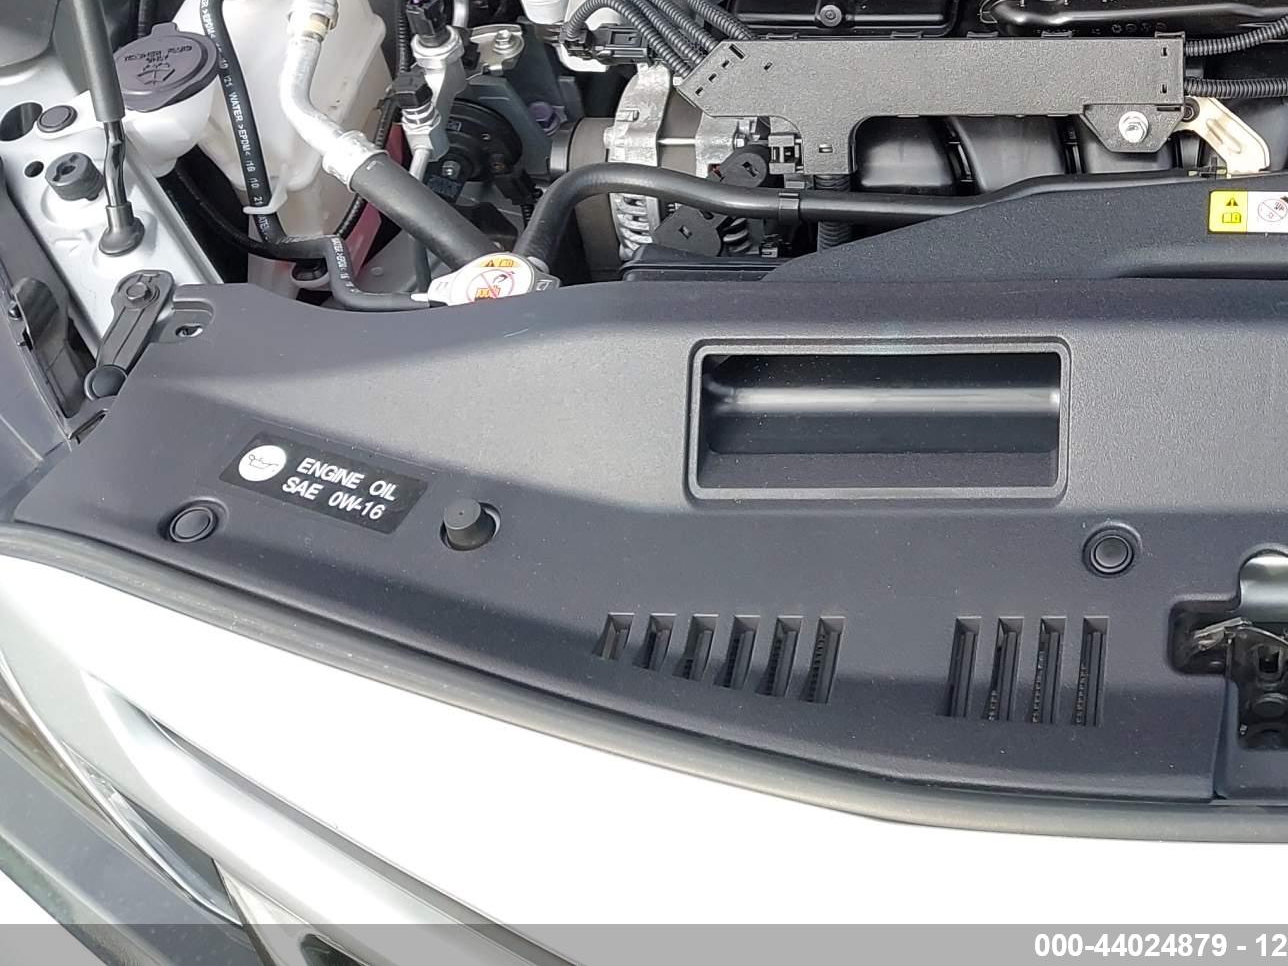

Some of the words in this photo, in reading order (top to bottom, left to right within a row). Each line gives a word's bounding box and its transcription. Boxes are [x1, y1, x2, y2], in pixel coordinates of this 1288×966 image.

[228, 92, 243, 122] WATER
[237, 124, 251, 156] >EPDM<
[282, 477, 324, 500] SAE
[328, 491, 386, 520] 0W-16
[296, 457, 365, 489] ENGINE
[369, 480, 398, 501] OIL
